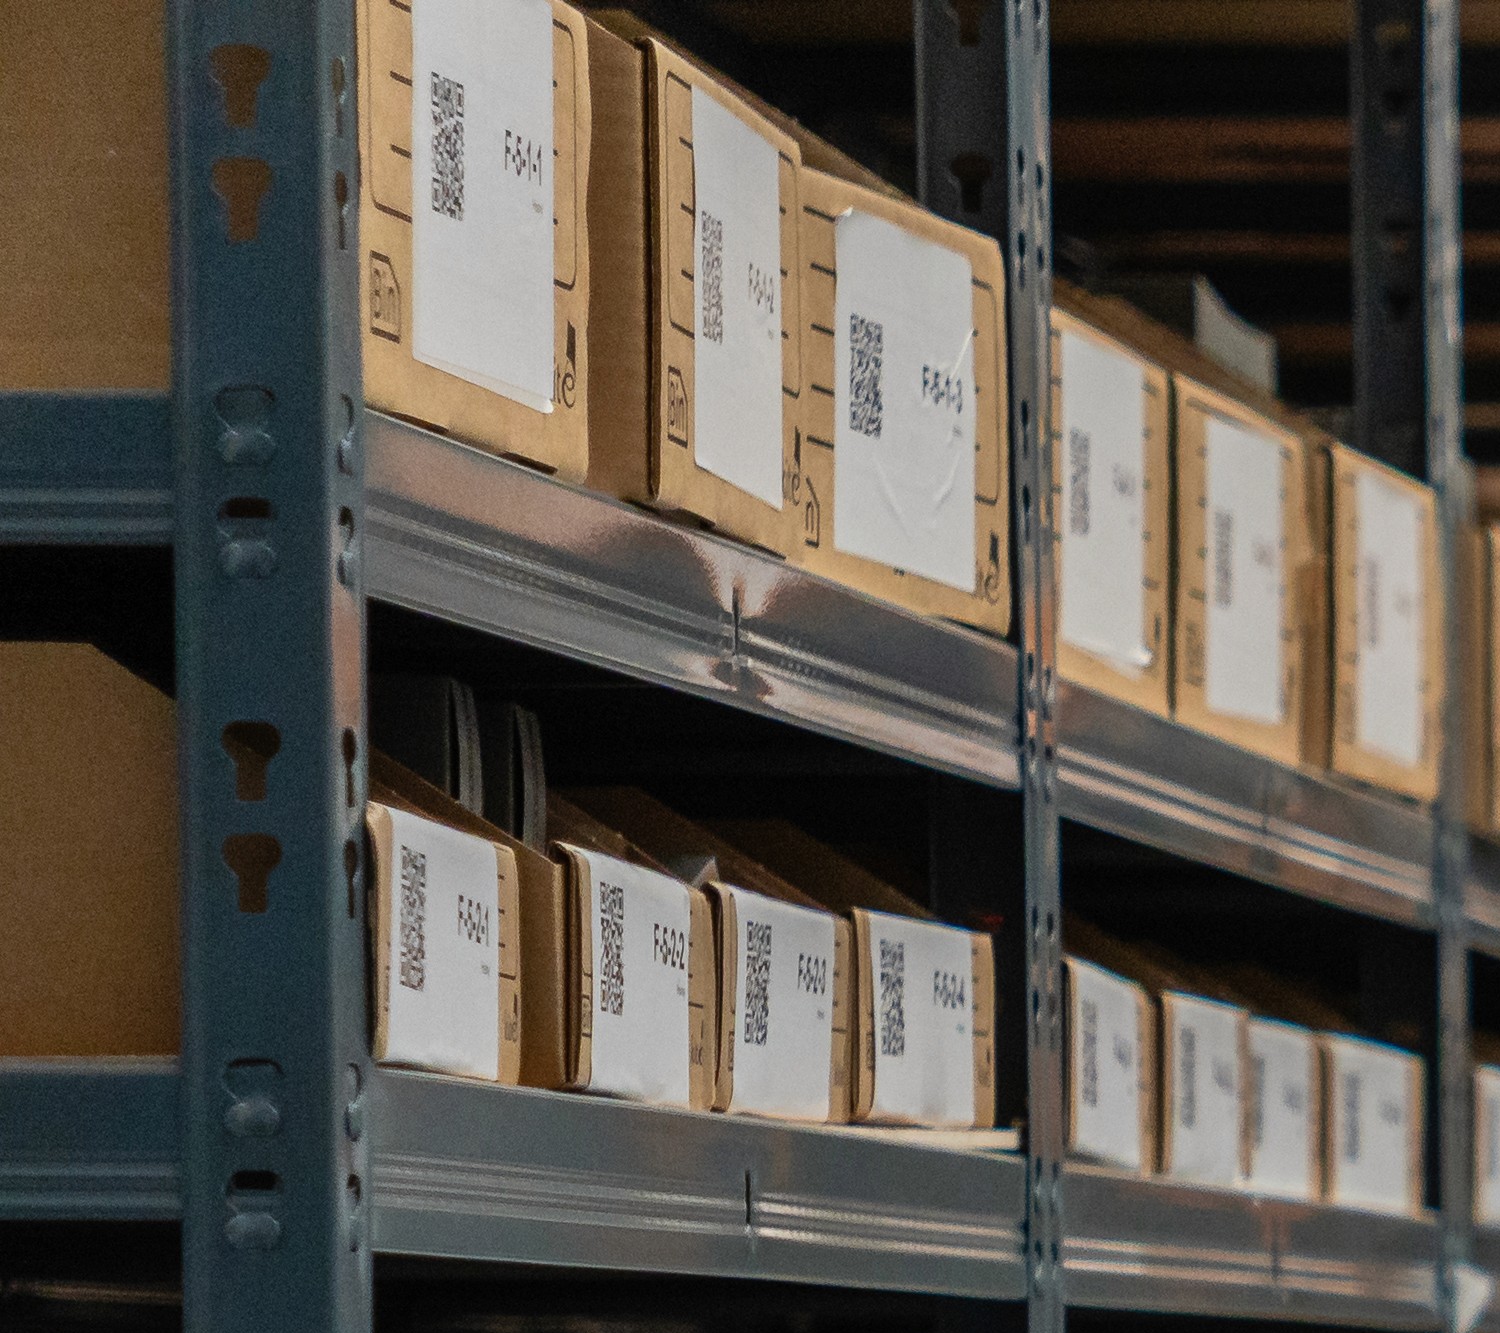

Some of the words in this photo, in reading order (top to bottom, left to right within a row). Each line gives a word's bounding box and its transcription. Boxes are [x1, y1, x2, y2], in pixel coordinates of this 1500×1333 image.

[505, 129, 542, 187] F-5-1-1
[371, 266, 397, 324] Bin
[670, 380, 686, 433] Bin
[922, 365, 962, 414] F-5-1-3
[458, 895, 489, 948] F-5-2-1
[654, 923, 685, 970] F-5-2-2
[798, 953, 826, 996] F-5-2-3
